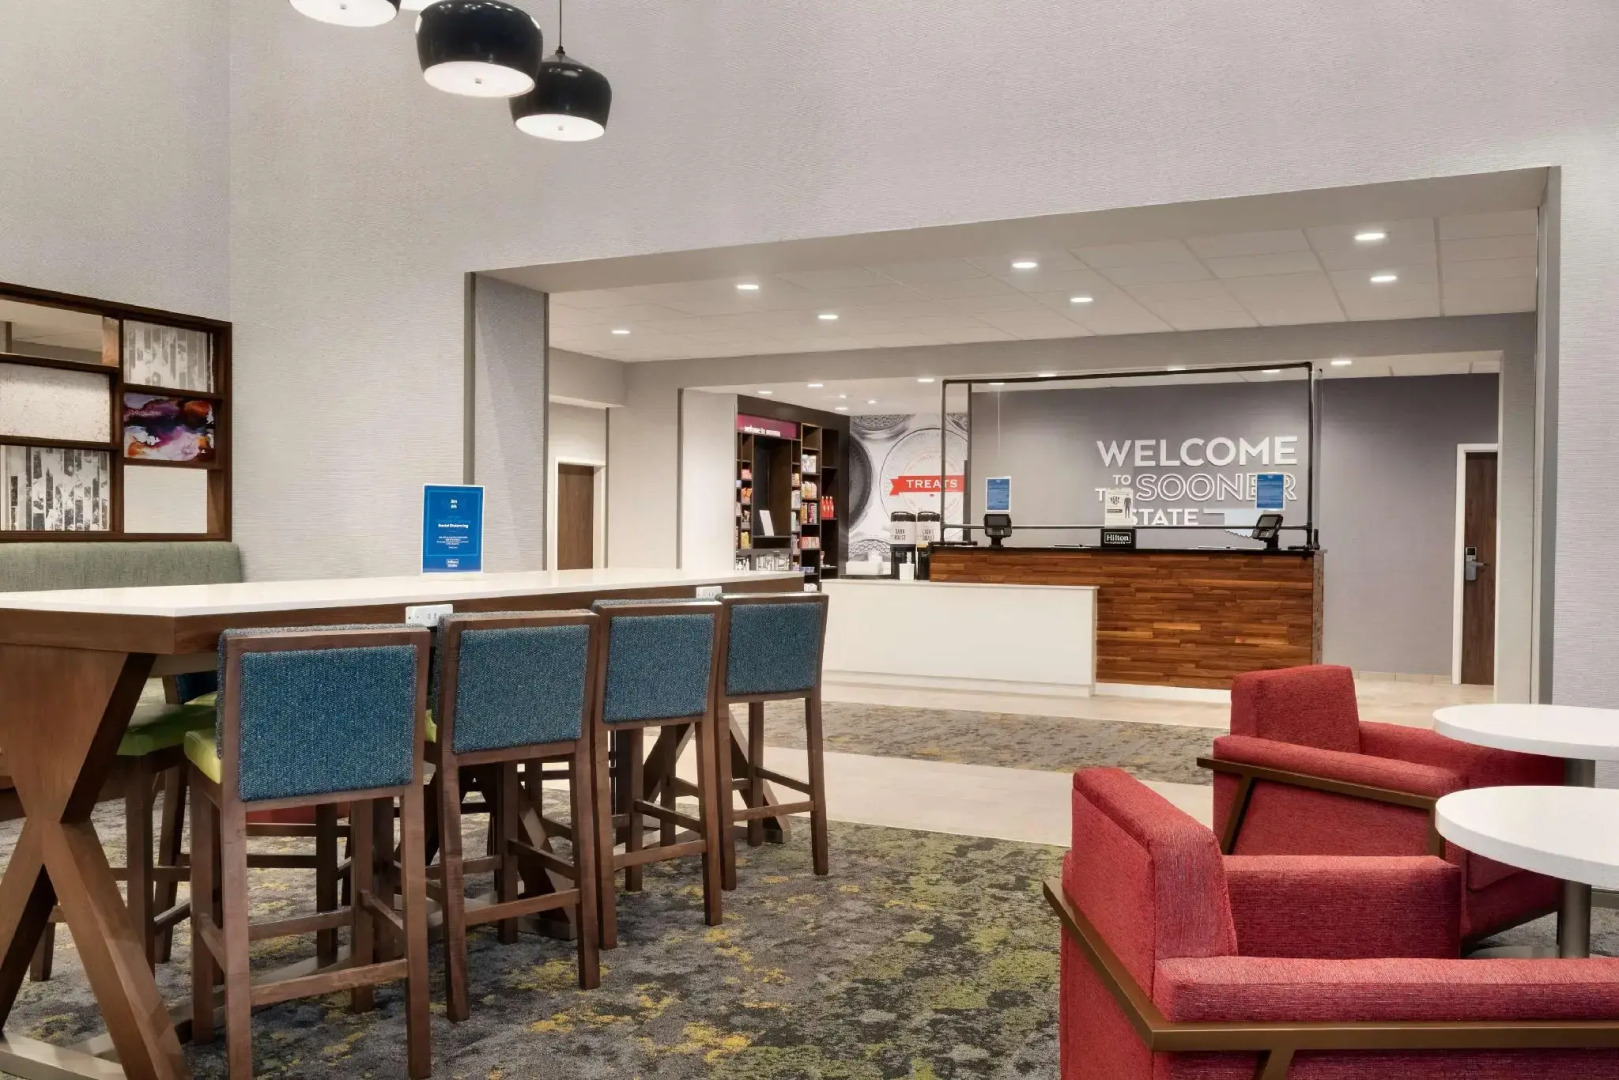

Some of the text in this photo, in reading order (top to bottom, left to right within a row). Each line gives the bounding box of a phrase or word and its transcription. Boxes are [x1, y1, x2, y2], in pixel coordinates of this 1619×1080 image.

[1096, 436, 1298, 467] WELCOME
[906, 479, 958, 488] TREATS
[1112, 474, 1132, 486] TO
[1106, 533, 1129, 541] Hilton
